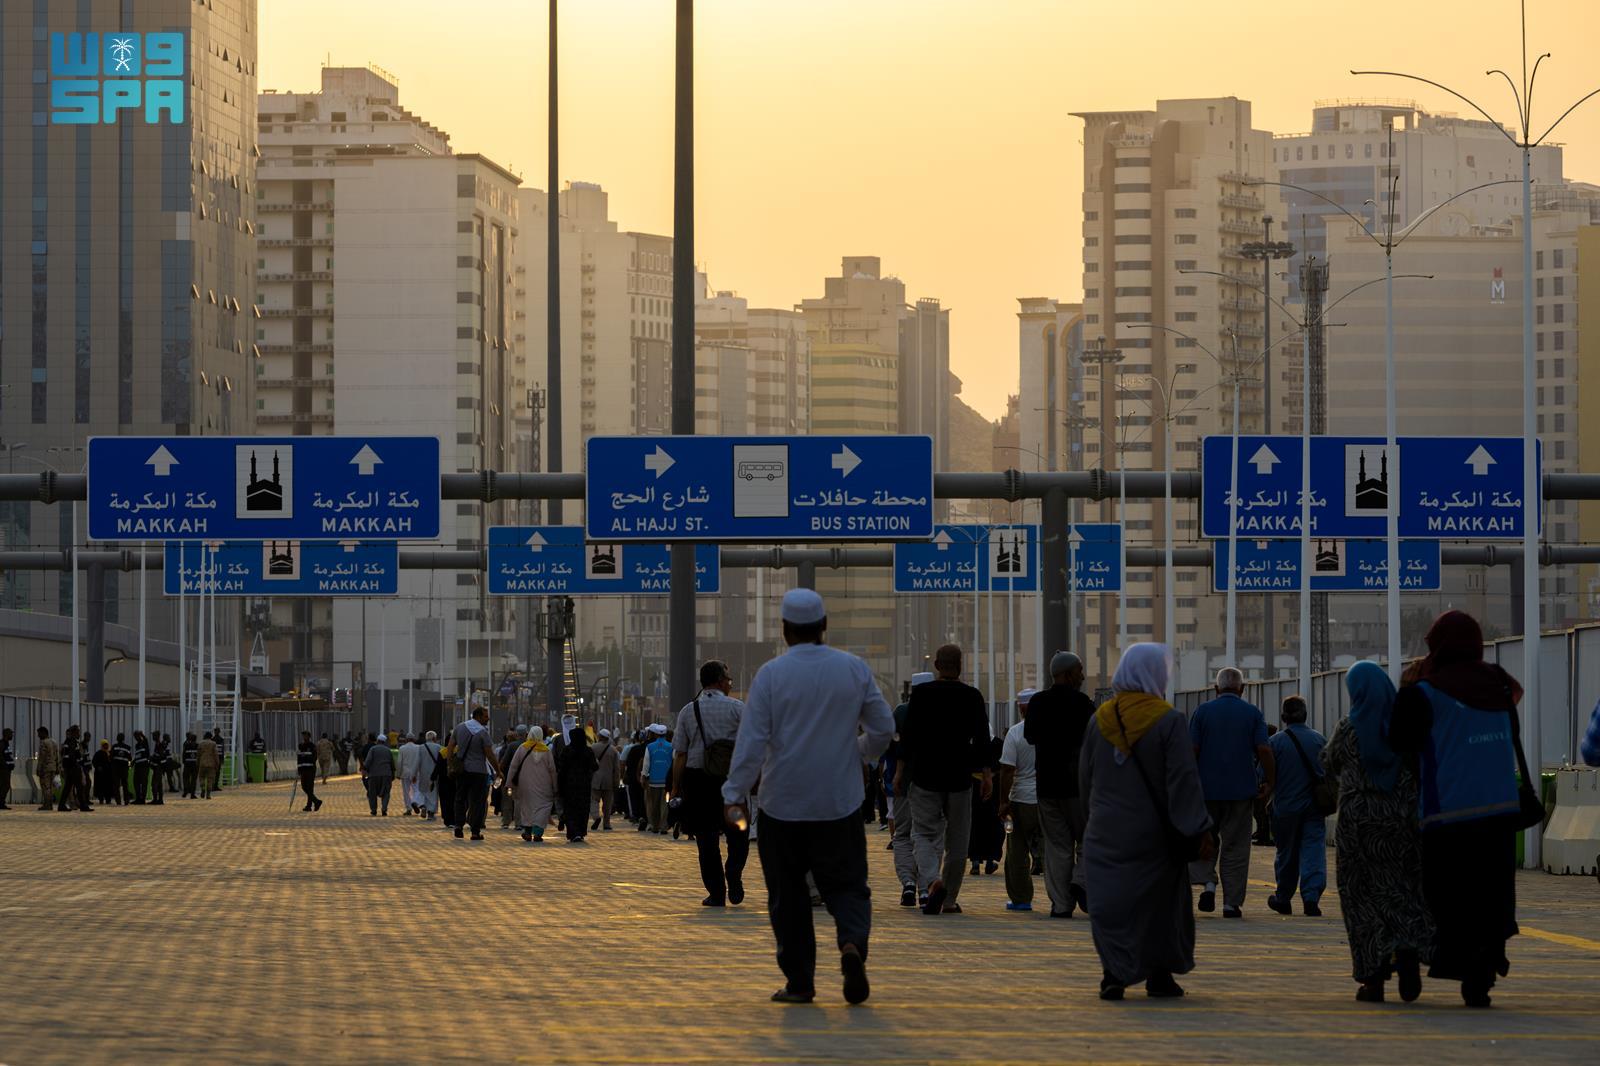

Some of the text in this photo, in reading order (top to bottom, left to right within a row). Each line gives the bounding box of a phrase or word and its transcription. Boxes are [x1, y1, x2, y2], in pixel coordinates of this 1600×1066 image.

[109, 491, 217, 513] مكة المكرمة
[312, 491, 420, 513] مكة المكرمة
[609, 485, 709, 512] شارع الحج
[793, 488, 927, 507] محطة حافلات
[1418, 491, 1522, 512] مكة المكرمة
[117, 518, 207, 533] MAKKAH
[322, 517, 412, 532] MAKKAH
[611, 517, 709, 532] AL HAJJ ST.
[811, 516, 911, 531] BUS STATION
[1428, 516, 1514, 531] MAKKAH
[227, 562, 250, 575] مكة
[313, 562, 385, 577] مكة المكرمة
[501, 561, 573, 576] مكة المكرمة
[907, 561, 951, 575] المكرمة
[1088, 561, 1110, 573] مكة
[1275, 560, 1297, 572] مكة
[1406, 559, 1428, 571] مكة
[319, 580, 379, 591] MAKKAH
[506, 579, 567, 590] MAKKAH
[912, 578, 972, 589] MAKKAH
[1234, 576, 1291, 587] MAKKAH
